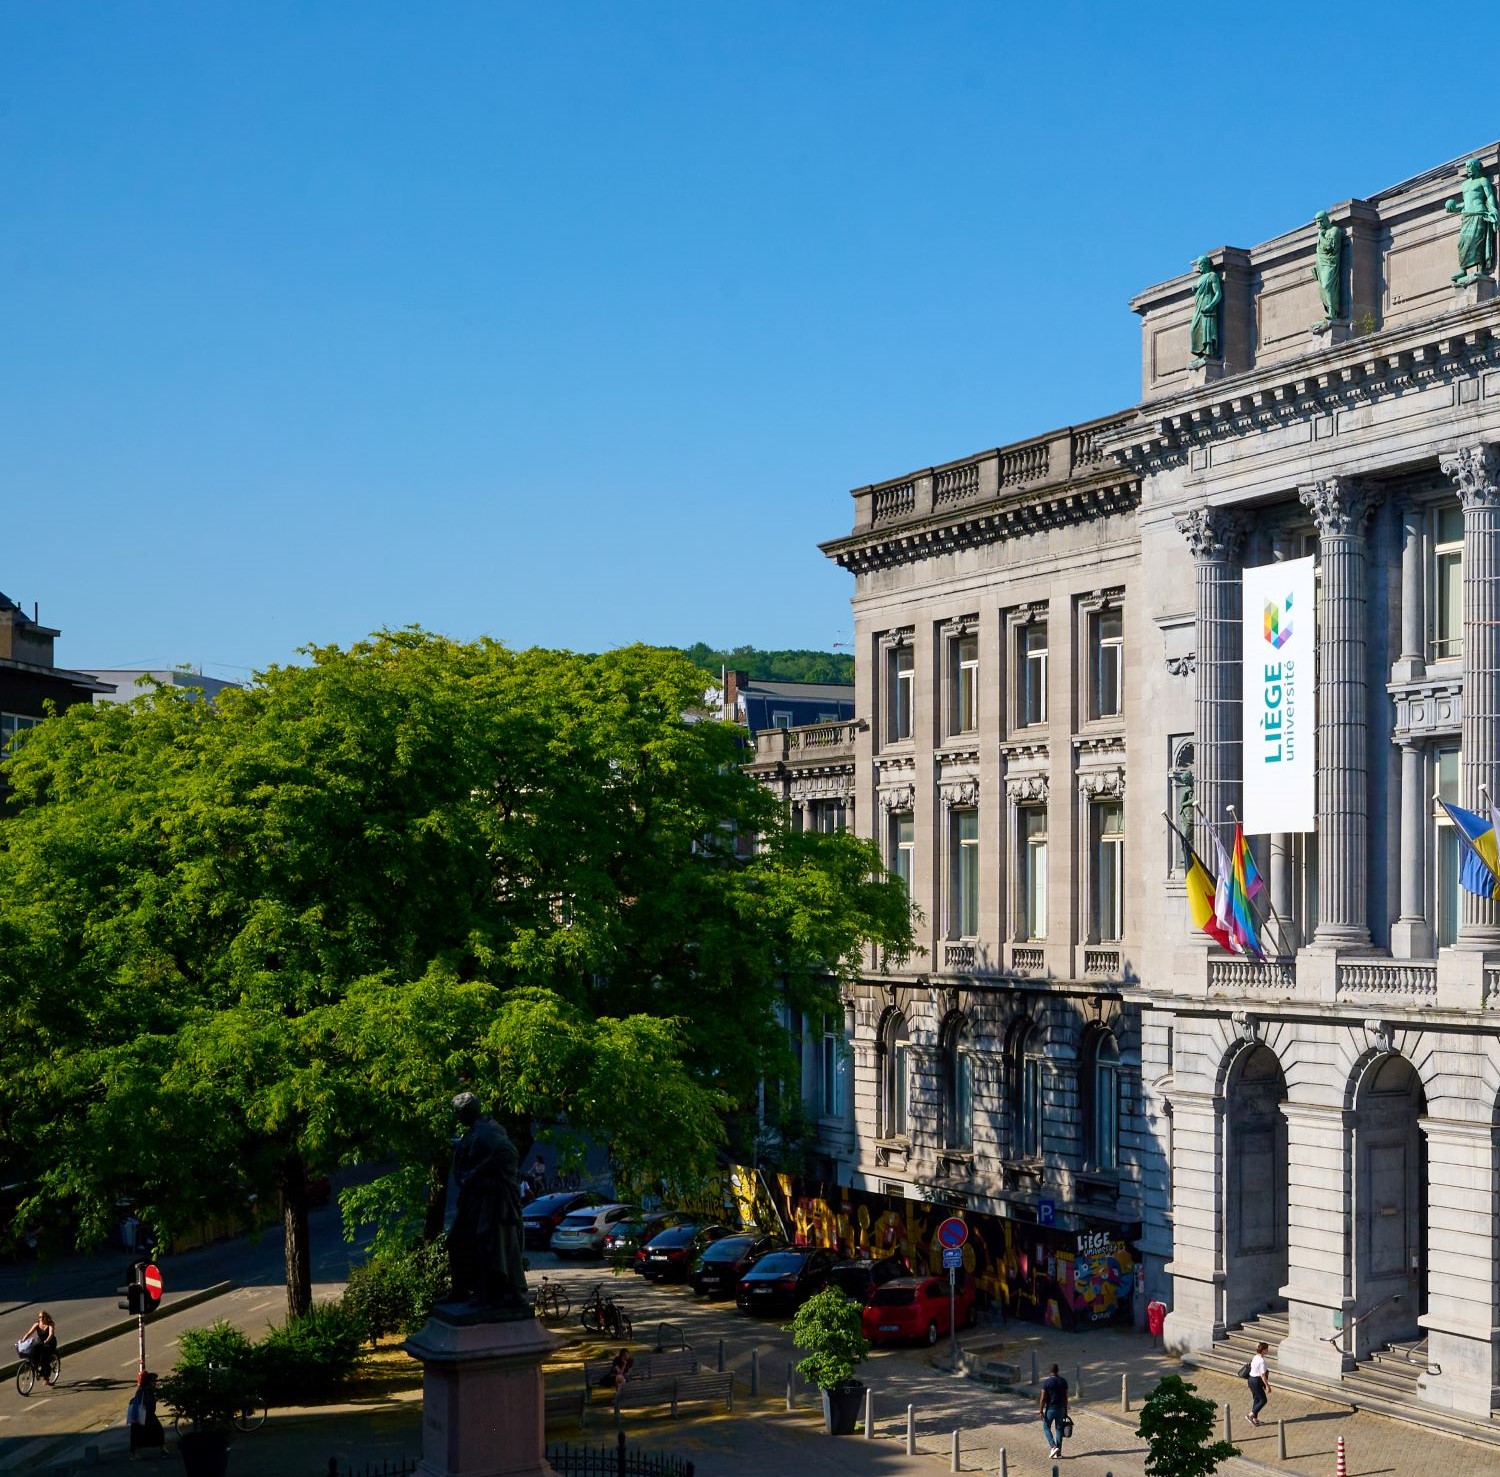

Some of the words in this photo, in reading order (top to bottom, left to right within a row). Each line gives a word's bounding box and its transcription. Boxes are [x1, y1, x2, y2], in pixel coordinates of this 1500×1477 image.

[1260, 661, 1282, 763] LIÈGE
[1284, 660, 1294, 761] université
[1040, 1204, 1053, 1222] P
